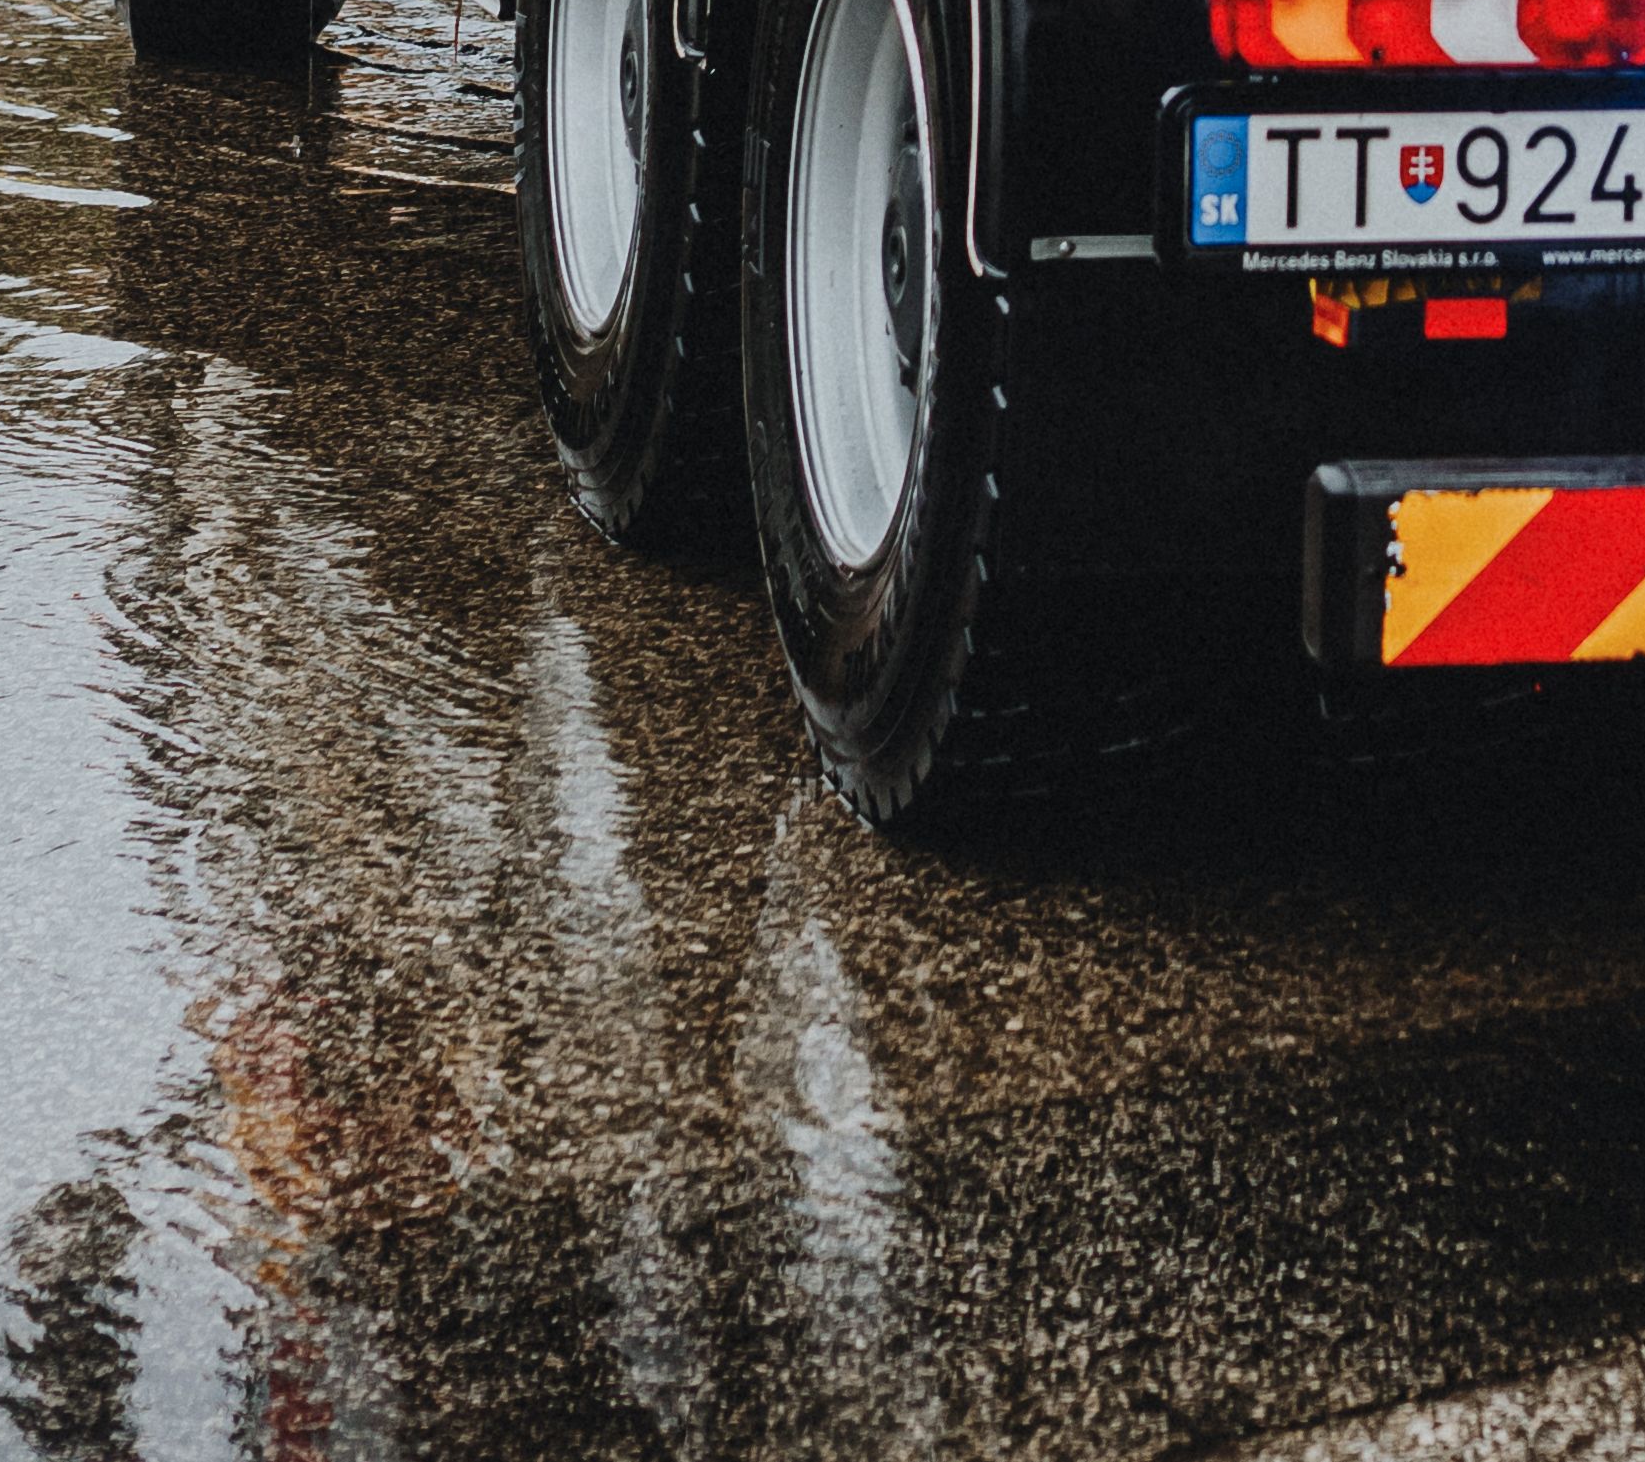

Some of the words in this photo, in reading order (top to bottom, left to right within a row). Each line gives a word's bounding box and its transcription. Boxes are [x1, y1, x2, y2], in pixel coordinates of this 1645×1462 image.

[1266, 127, 1390, 229] TT
[1199, 192, 1239, 227] SK
[1381, 247, 1454, 269] Slovakia
